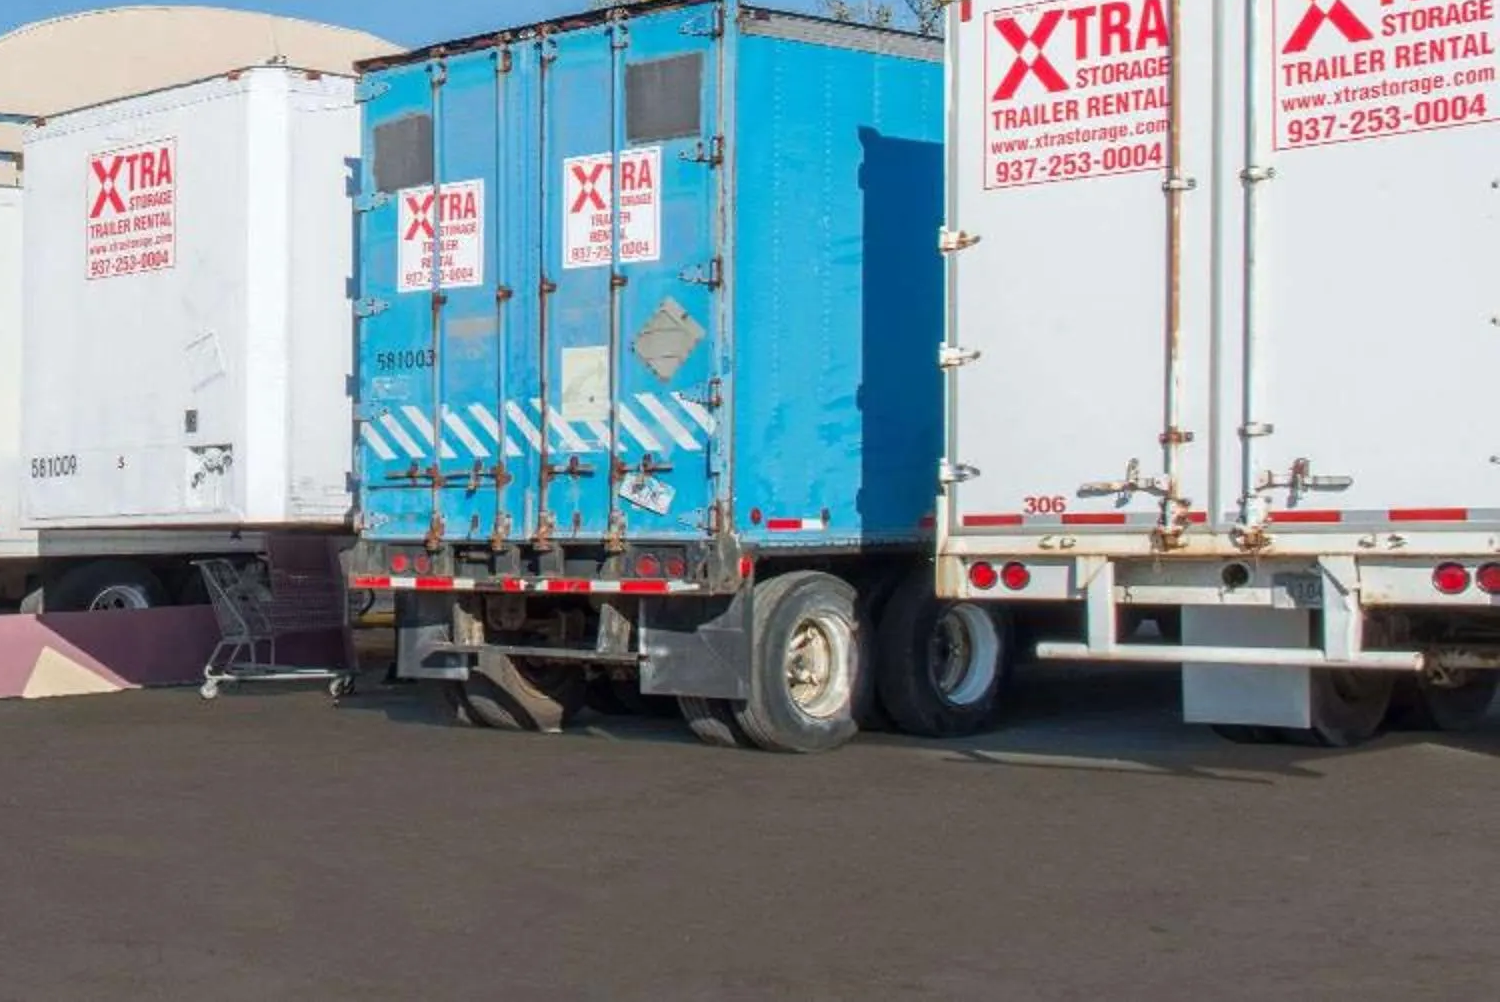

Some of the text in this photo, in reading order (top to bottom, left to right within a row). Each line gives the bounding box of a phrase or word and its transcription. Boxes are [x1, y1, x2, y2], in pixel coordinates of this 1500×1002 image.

[1075, 55, 1172, 89] STORAGE
[1281, 31, 1495, 87] TRAILER RENTAL
[1281, 66, 1496, 112] www.xtrastorage.com
[991, 85, 1172, 131] TRAILER RENTAL
[1287, 93, 1487, 144] 937-253-0004
[991, 118, 1171, 155] www.xtrastorage.com
[995, 142, 1163, 183] 937-253-0004
[90, 147, 173, 218] XTRA
[571, 158, 653, 214] XTRA
[90, 211, 172, 239] TRAILER RENTAL
[404, 191, 477, 241] XTRA
[591, 211, 631, 227] TRAIER
[91, 250, 169, 276] 937-253-0004
[405, 268, 474, 287] 937-23-0004
[377, 349, 436, 371] 581003
[31, 454, 77, 479] 581009
[1023, 496, 1067, 514] 306
